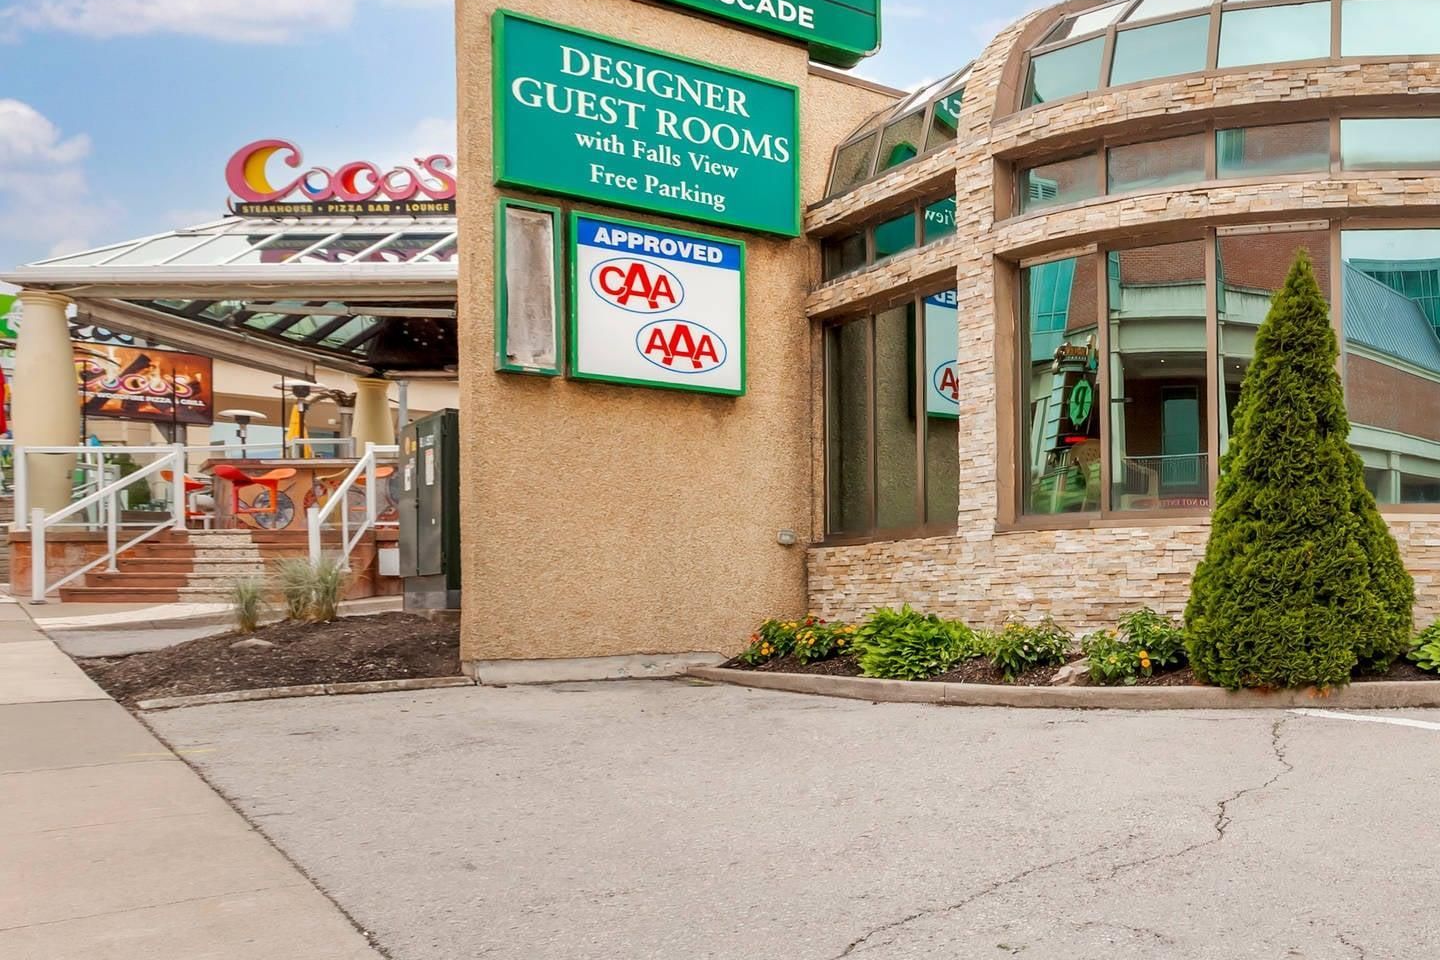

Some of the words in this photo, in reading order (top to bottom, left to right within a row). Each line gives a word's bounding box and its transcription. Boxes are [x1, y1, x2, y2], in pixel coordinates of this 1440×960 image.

[560, 45, 750, 118] DESIGNER
[511, 77, 645, 130] GUEST
[656, 109, 790, 163] ROOMS
[574, 131, 625, 156] with
[632, 139, 681, 167] Falls
[688, 151, 739, 179] View
[241, 204, 313, 214] STEAKHOUSE
[327, 204, 364, 213] PIZZA
[367, 204, 391, 213] BAR
[405, 203, 450, 212] LOUNGE
[589, 163, 638, 191] Free
[644, 174, 726, 212] Parking
[593, 226, 723, 264] APPROVED
[599, 262, 676, 310] CAA
[645, 324, 719, 369] AAA
